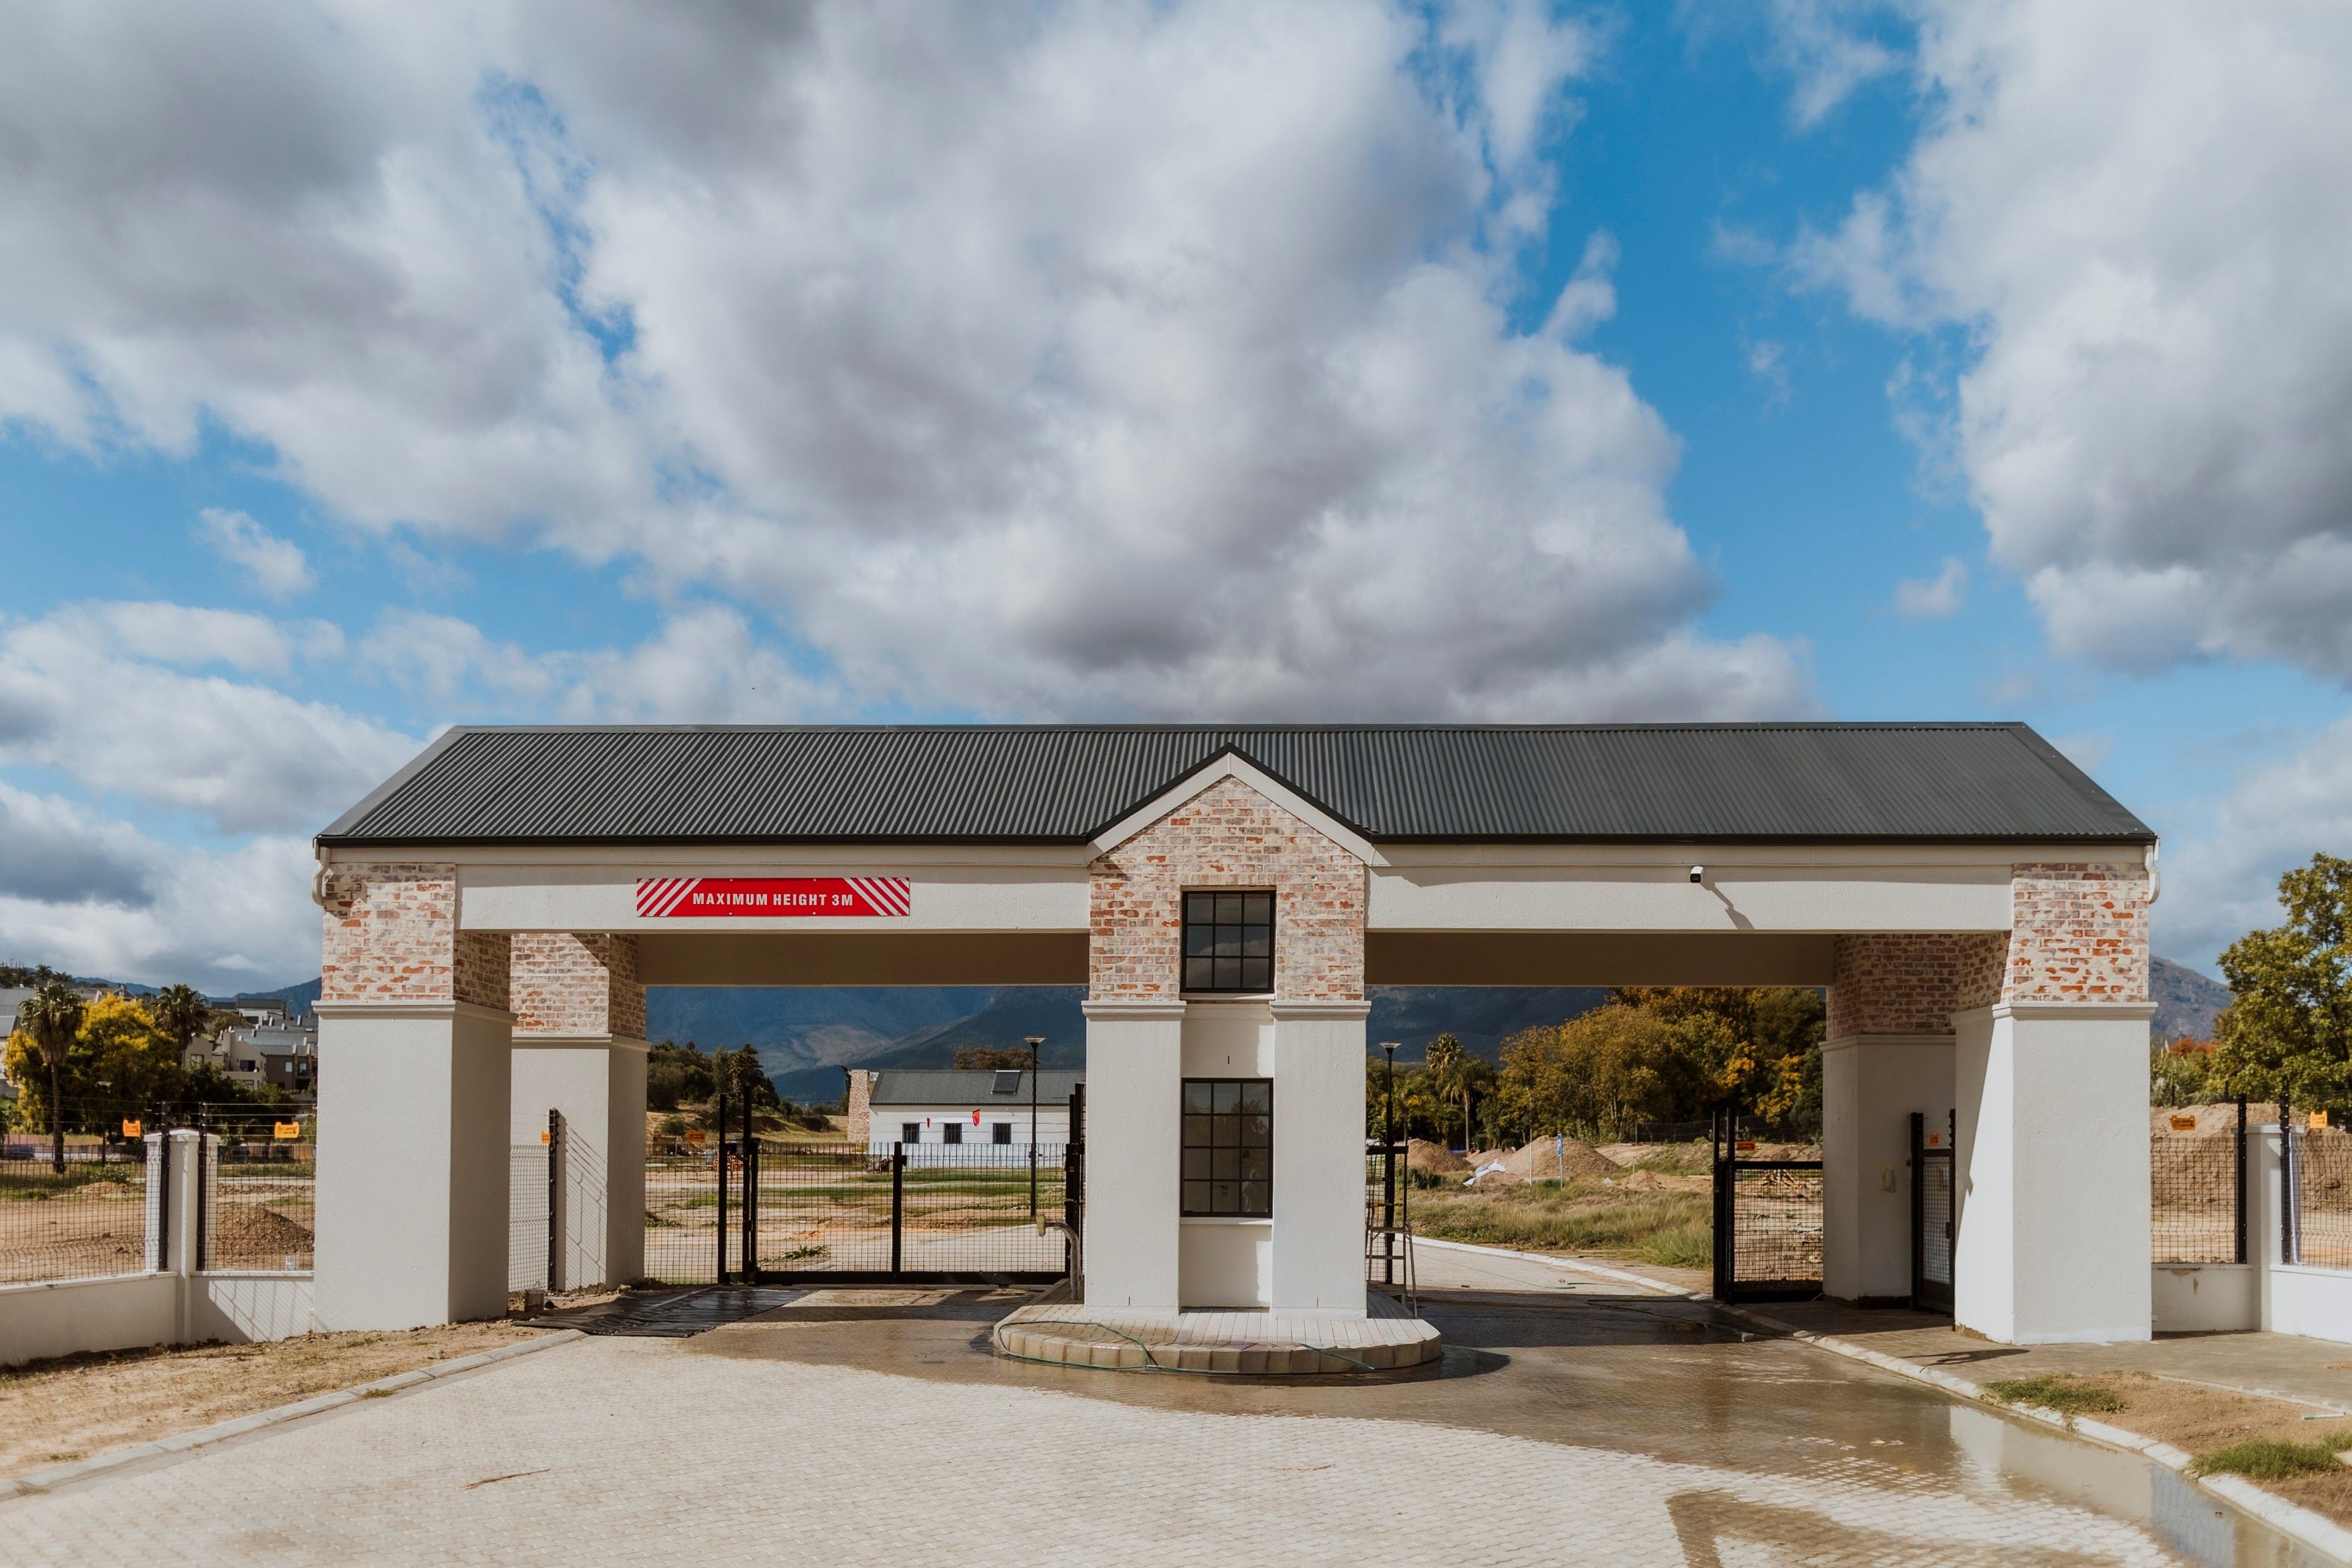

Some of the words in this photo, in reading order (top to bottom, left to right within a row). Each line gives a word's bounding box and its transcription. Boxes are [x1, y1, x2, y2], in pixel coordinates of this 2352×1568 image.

[693, 893, 767, 905] MAXIMUM
[773, 894, 827, 906] HEIGHT
[831, 894, 853, 906] 3M
